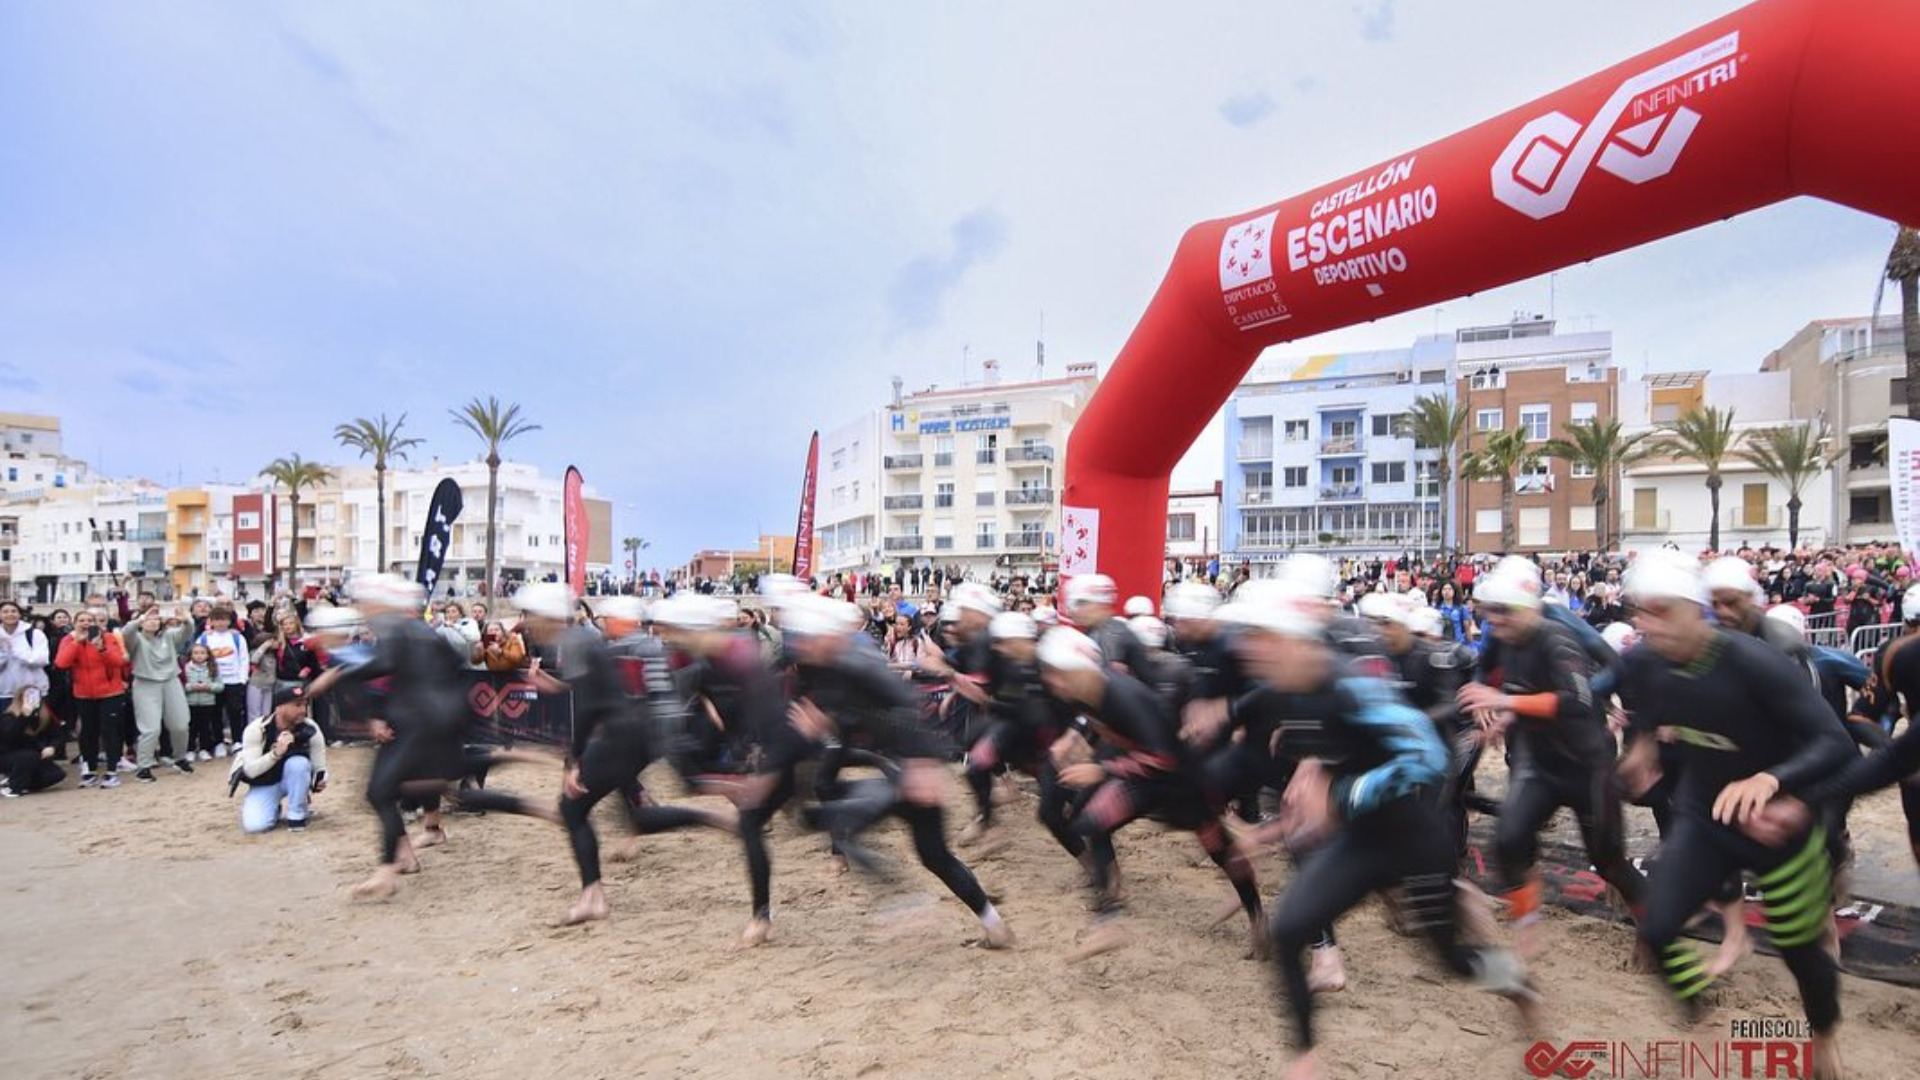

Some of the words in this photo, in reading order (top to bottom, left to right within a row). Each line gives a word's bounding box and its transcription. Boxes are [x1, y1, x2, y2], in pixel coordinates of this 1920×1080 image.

[1633, 58, 1738, 119] INFINITRI
[1310, 156, 1417, 219] CASTELLÓN
[1287, 184, 1438, 272] ESCENARIO
[1224, 278, 1277, 304] DIPUTACIÓ
[1313, 247, 1407, 286] DEPORTIVO
[1233, 303, 1288, 325] CASTELLÓ
